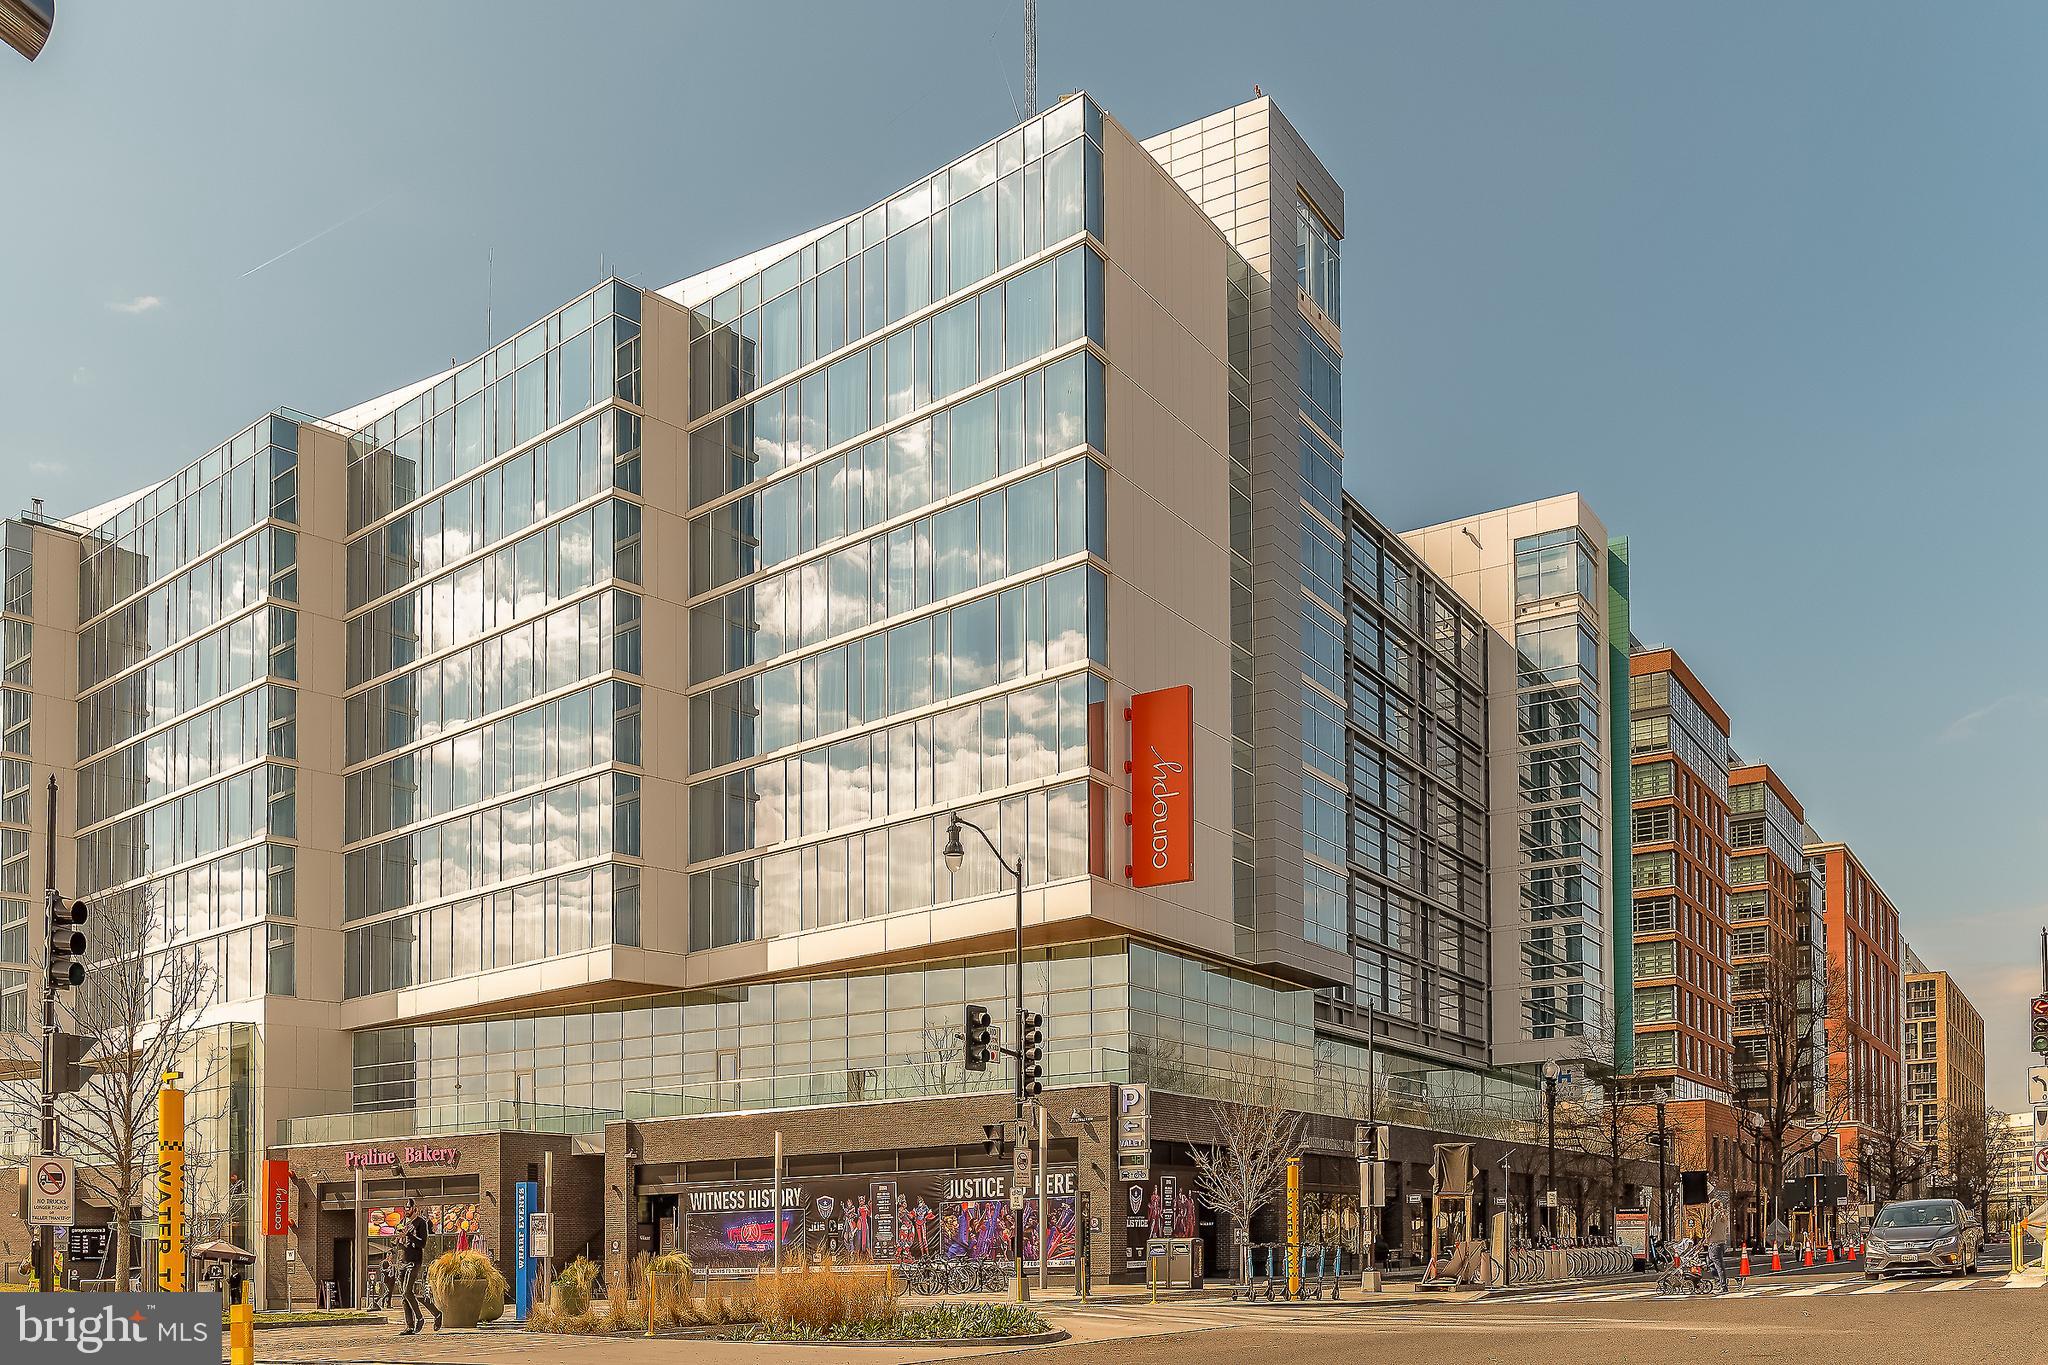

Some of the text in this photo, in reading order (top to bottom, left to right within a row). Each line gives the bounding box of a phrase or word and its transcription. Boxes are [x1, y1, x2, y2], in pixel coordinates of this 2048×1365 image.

[1150, 745, 1184, 869] canopy
[1121, 1087, 1140, 1113] P
[344, 1143, 458, 1168] Praline Bakery
[1119, 1139, 1143, 1147] VALET
[689, 1190, 745, 1211] WITNESS
[949, 1176, 1005, 1200] JUSTICE
[158, 1160, 172, 1254] WATER
[274, 1181, 288, 1231] canopy
[518, 1187, 526, 1269] WHARF EVENTS
